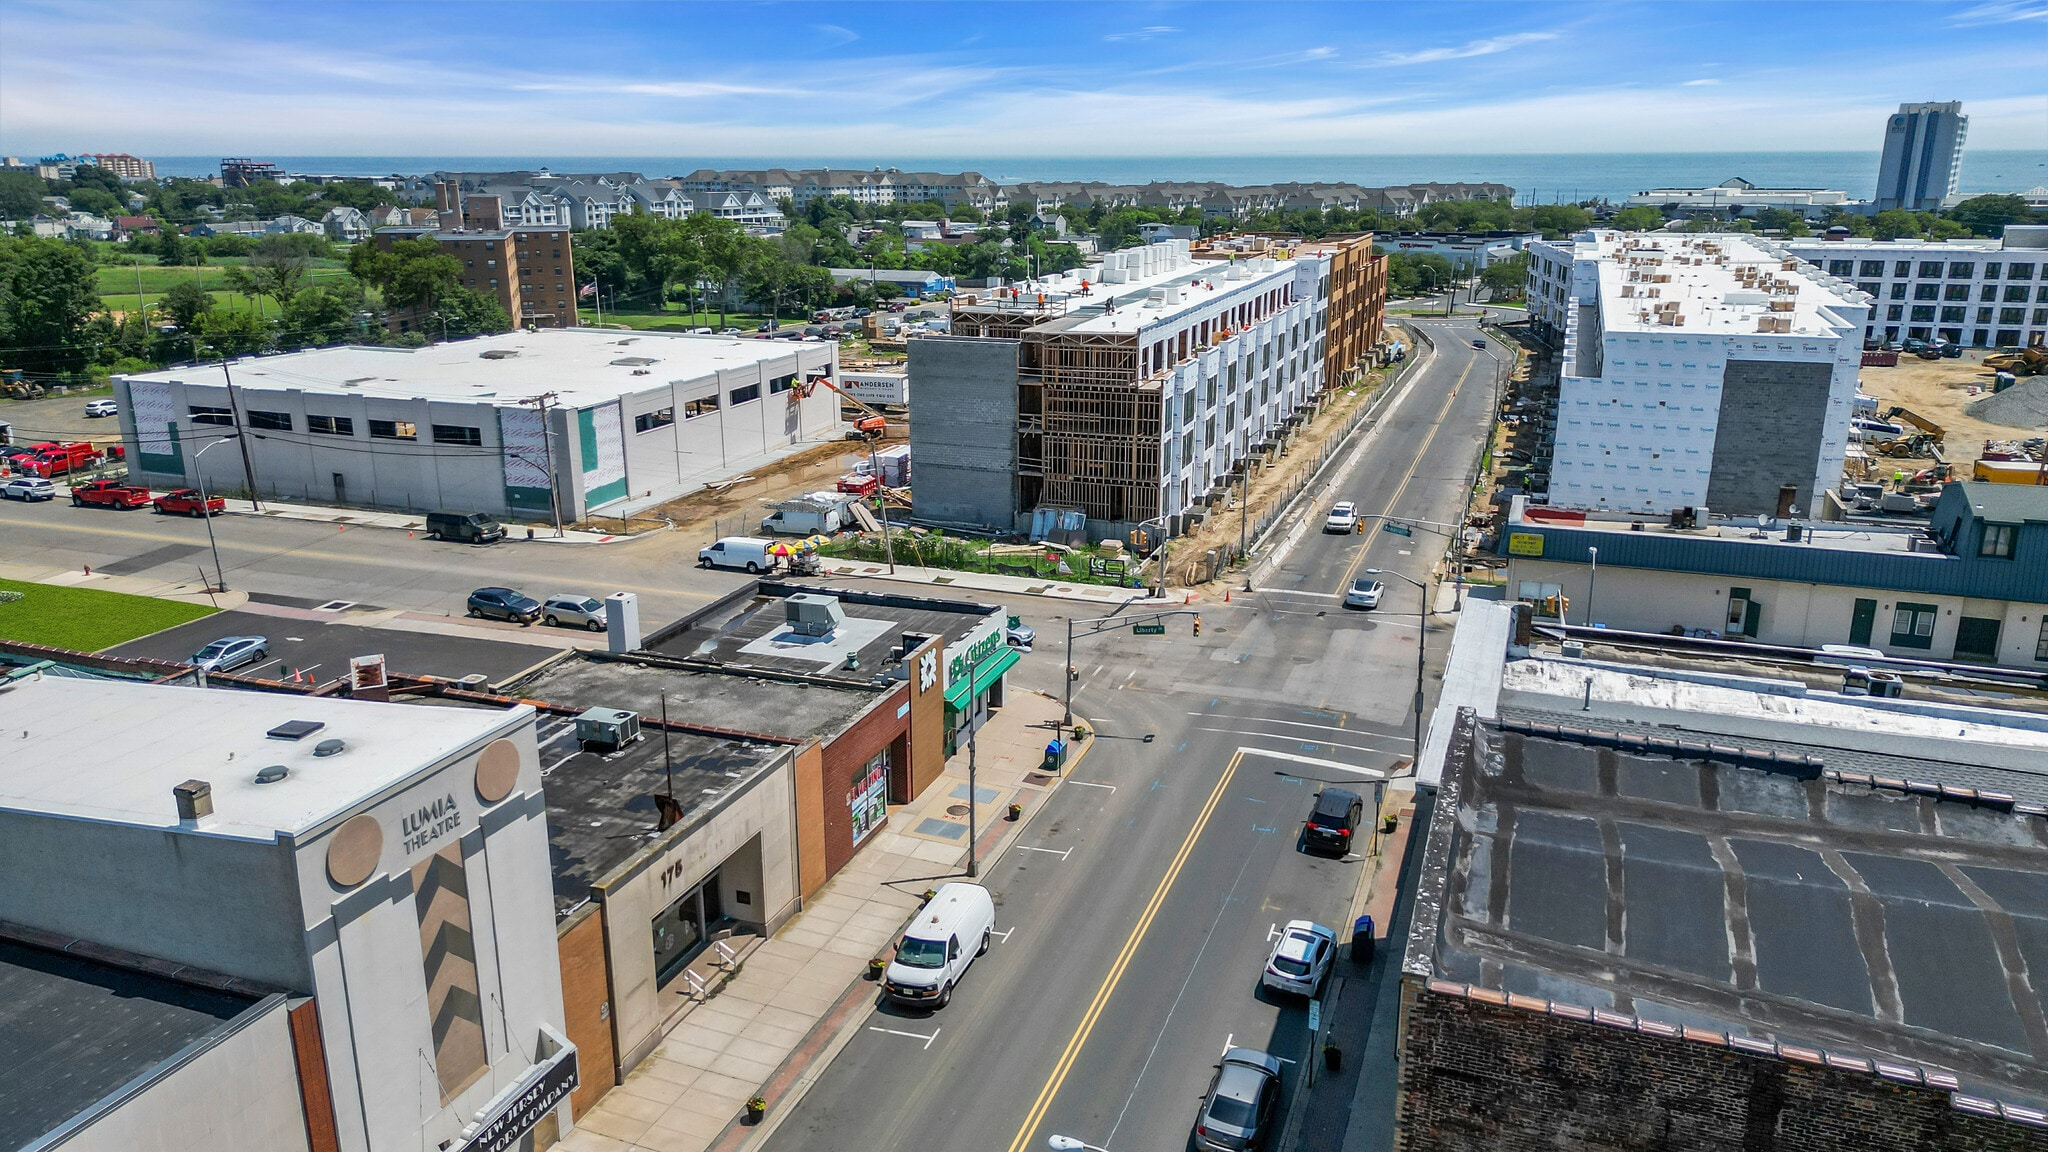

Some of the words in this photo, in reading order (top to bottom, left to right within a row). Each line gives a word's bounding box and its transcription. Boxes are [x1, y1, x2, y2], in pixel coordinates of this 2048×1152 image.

[965, 627, 1000, 669] Citizens
[402, 792, 457, 837] LUMIA
[404, 812, 461, 856] THEATRE
[479, 1116, 505, 1148] NEW
[506, 1080, 546, 1124] JERSEY
[522, 1072, 576, 1128] COMPANY
